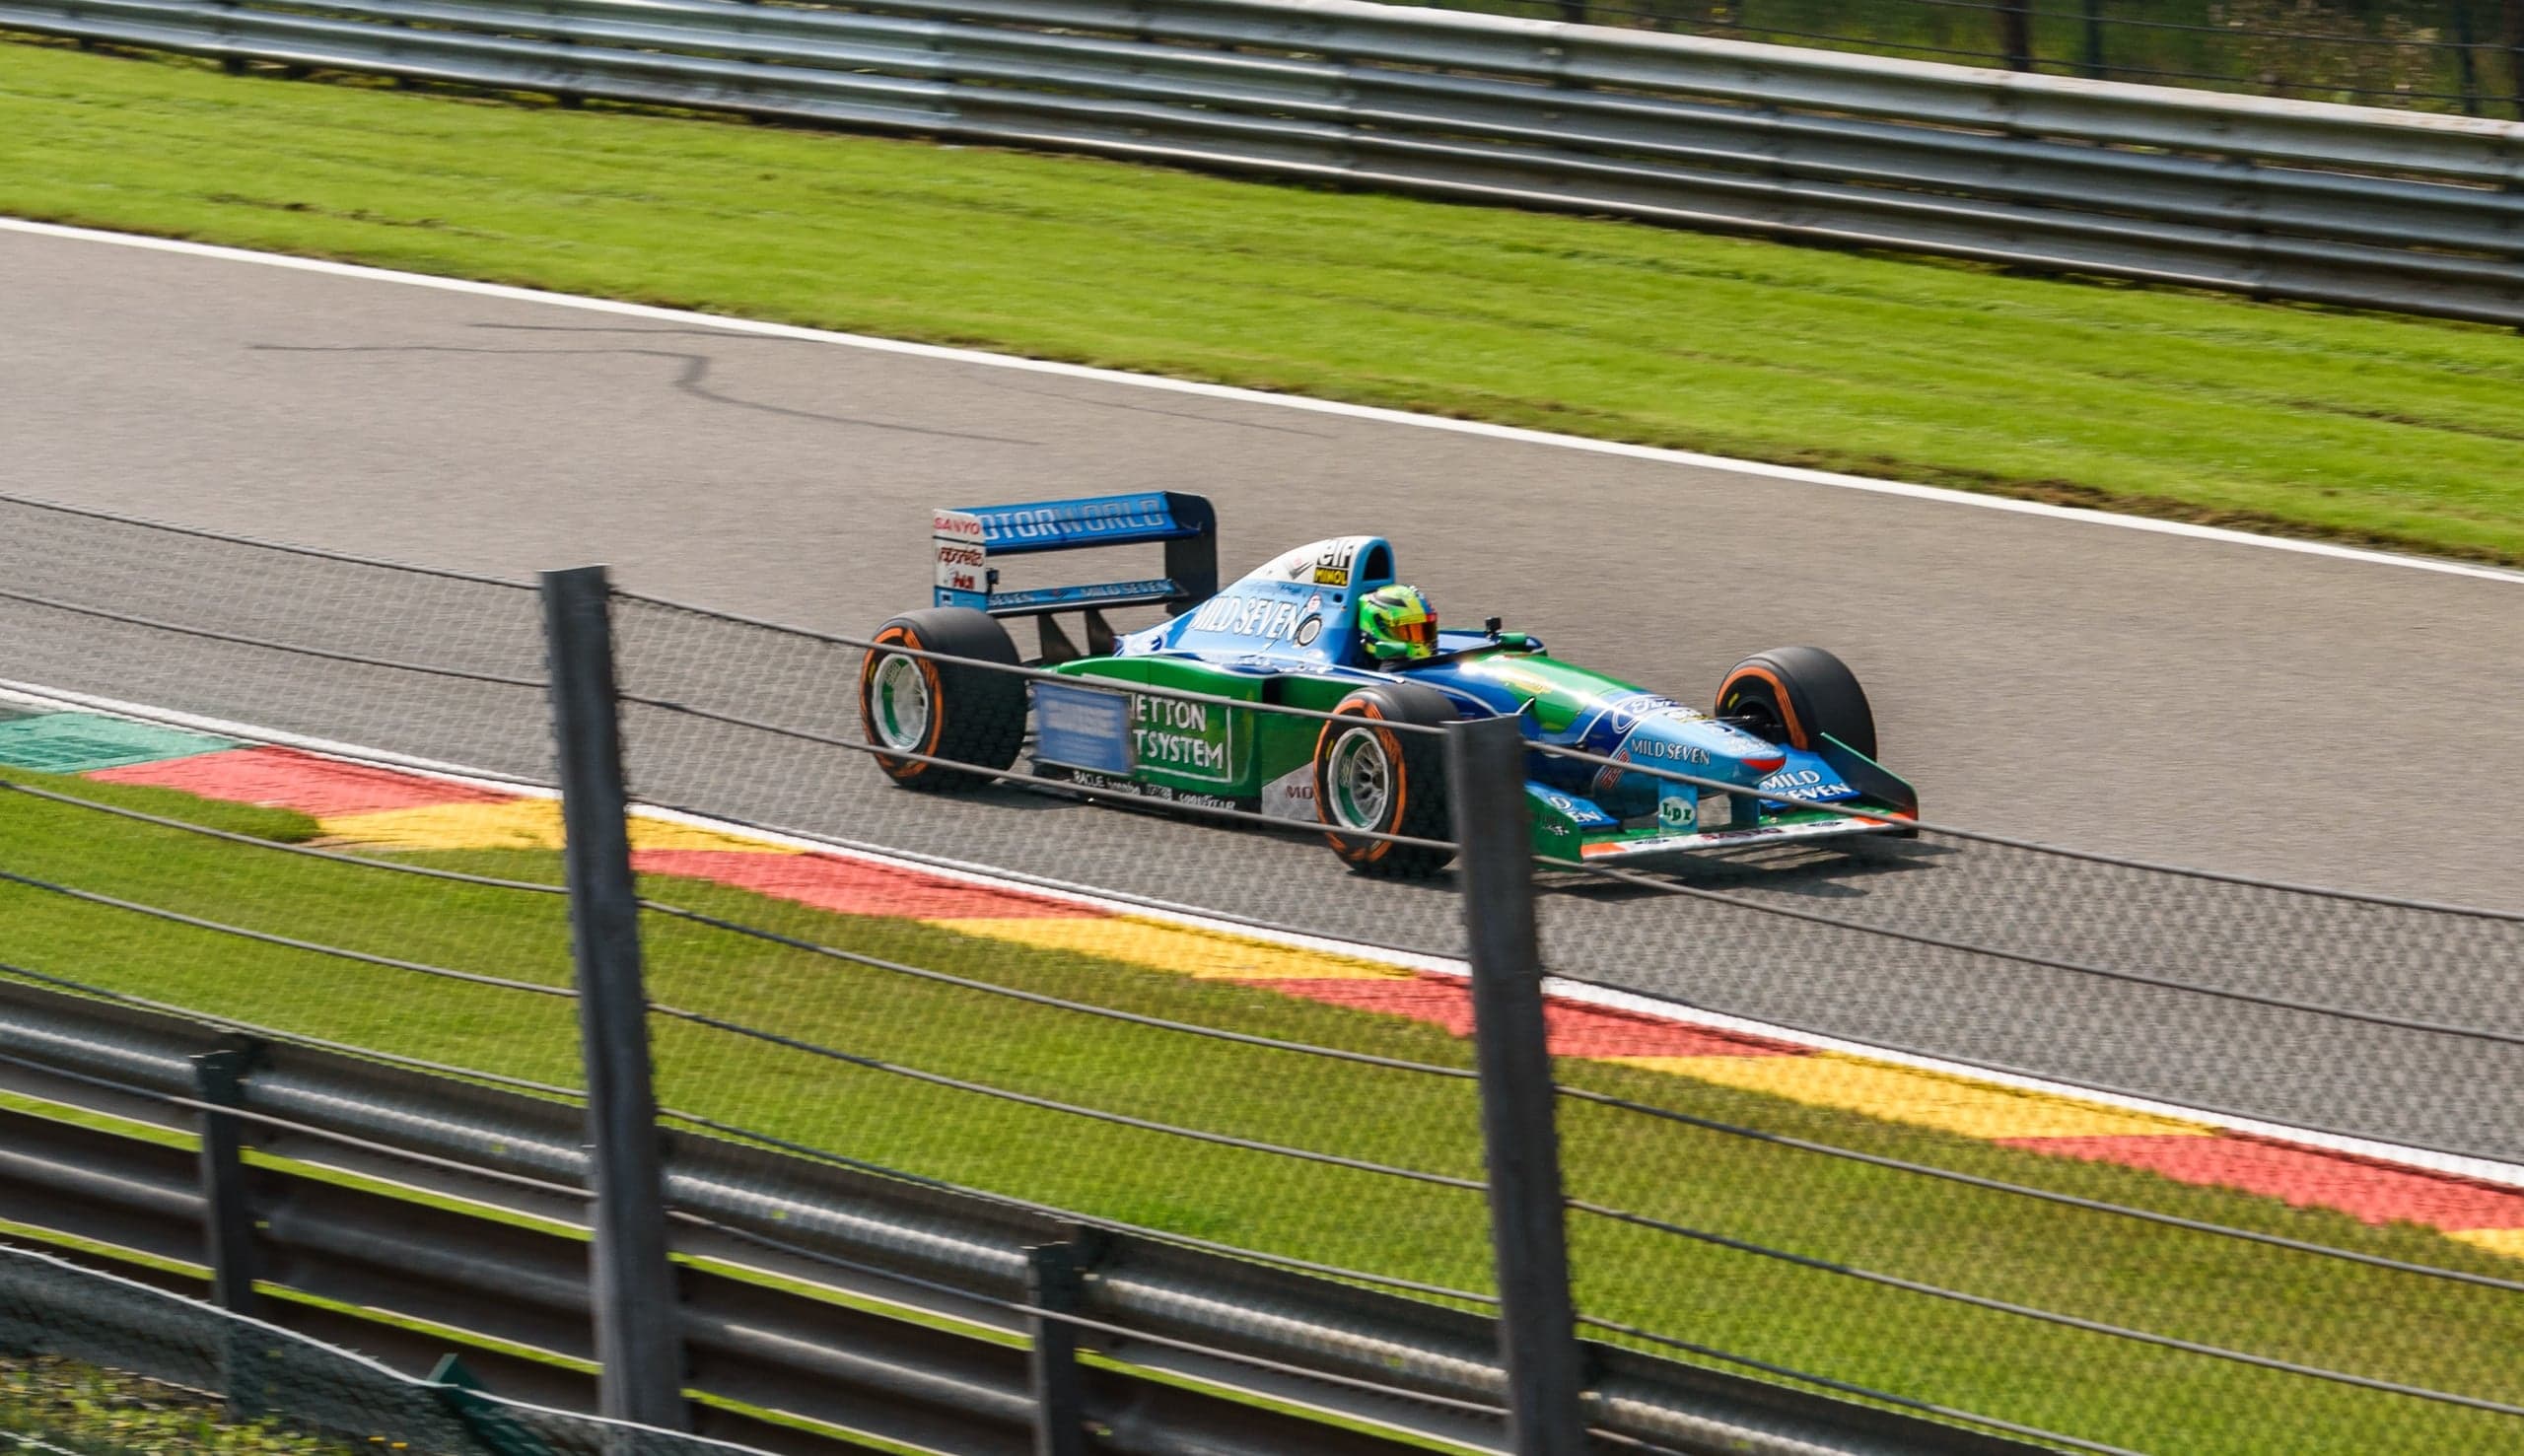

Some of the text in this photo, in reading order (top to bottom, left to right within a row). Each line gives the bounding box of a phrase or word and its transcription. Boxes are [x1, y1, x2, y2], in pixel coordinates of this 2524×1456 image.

[975, 497, 1165, 540] OTORWORLD
[1189, 595, 1237, 631] MILD
[1234, 596, 1306, 641] SEVEN
[1131, 693, 1207, 732] ETTON
[1631, 738, 1711, 765] MILD SEVEN
[1764, 770, 1821, 790] MILD
